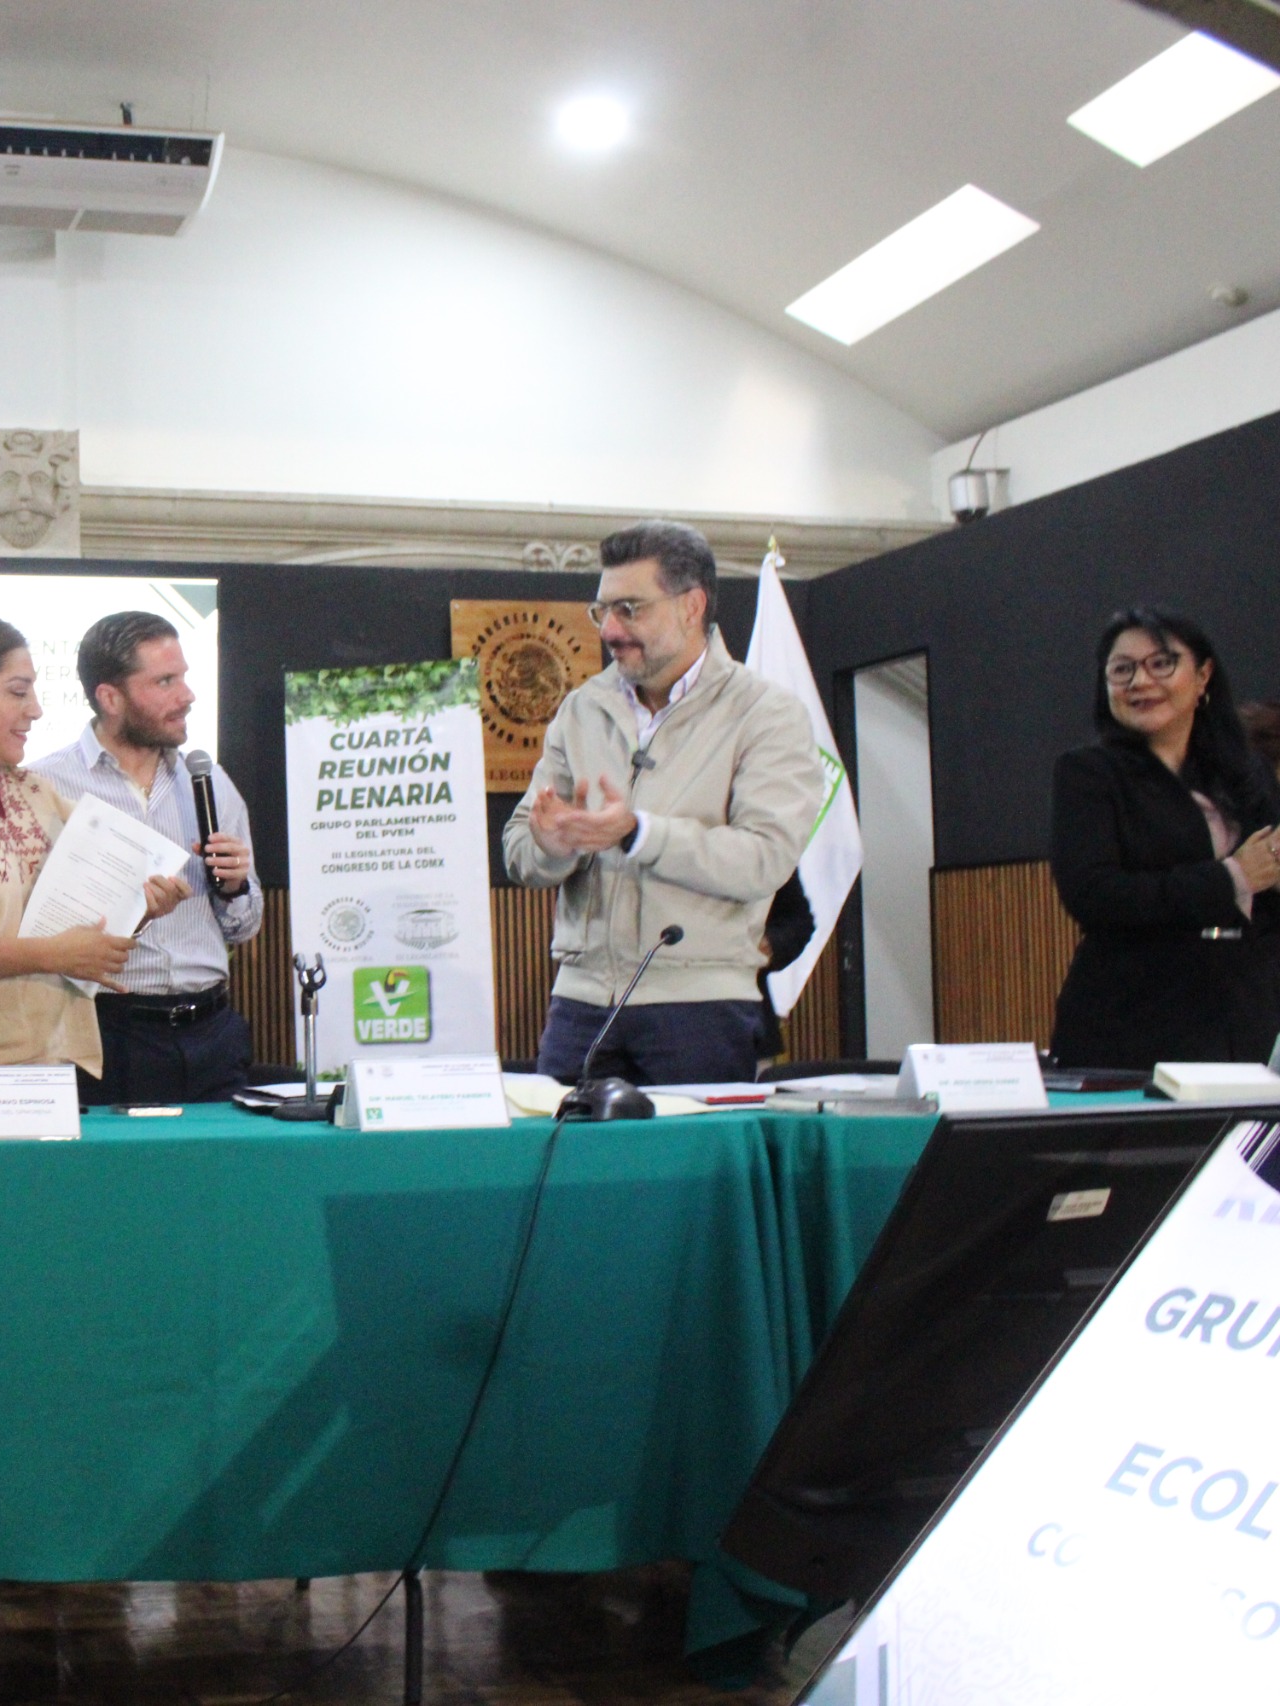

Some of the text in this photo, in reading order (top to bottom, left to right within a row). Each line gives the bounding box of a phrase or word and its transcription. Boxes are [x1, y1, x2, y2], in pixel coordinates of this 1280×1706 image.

[329, 726, 433, 751] CUARTA
[318, 748, 451, 780] REUNIÓN
[316, 781, 453, 811] PLENARIA
[310, 814, 456, 831] GRUPO PARLAMENTARIO
[356, 828, 415, 839] DEL PVEM
[345, 848, 413, 859] LEGISLATURA
[321, 862, 378, 874] CONGRESO
[382, 861, 394, 871] DE
[398, 860, 411, 870] LA
[357, 1018, 427, 1040] VERDE
